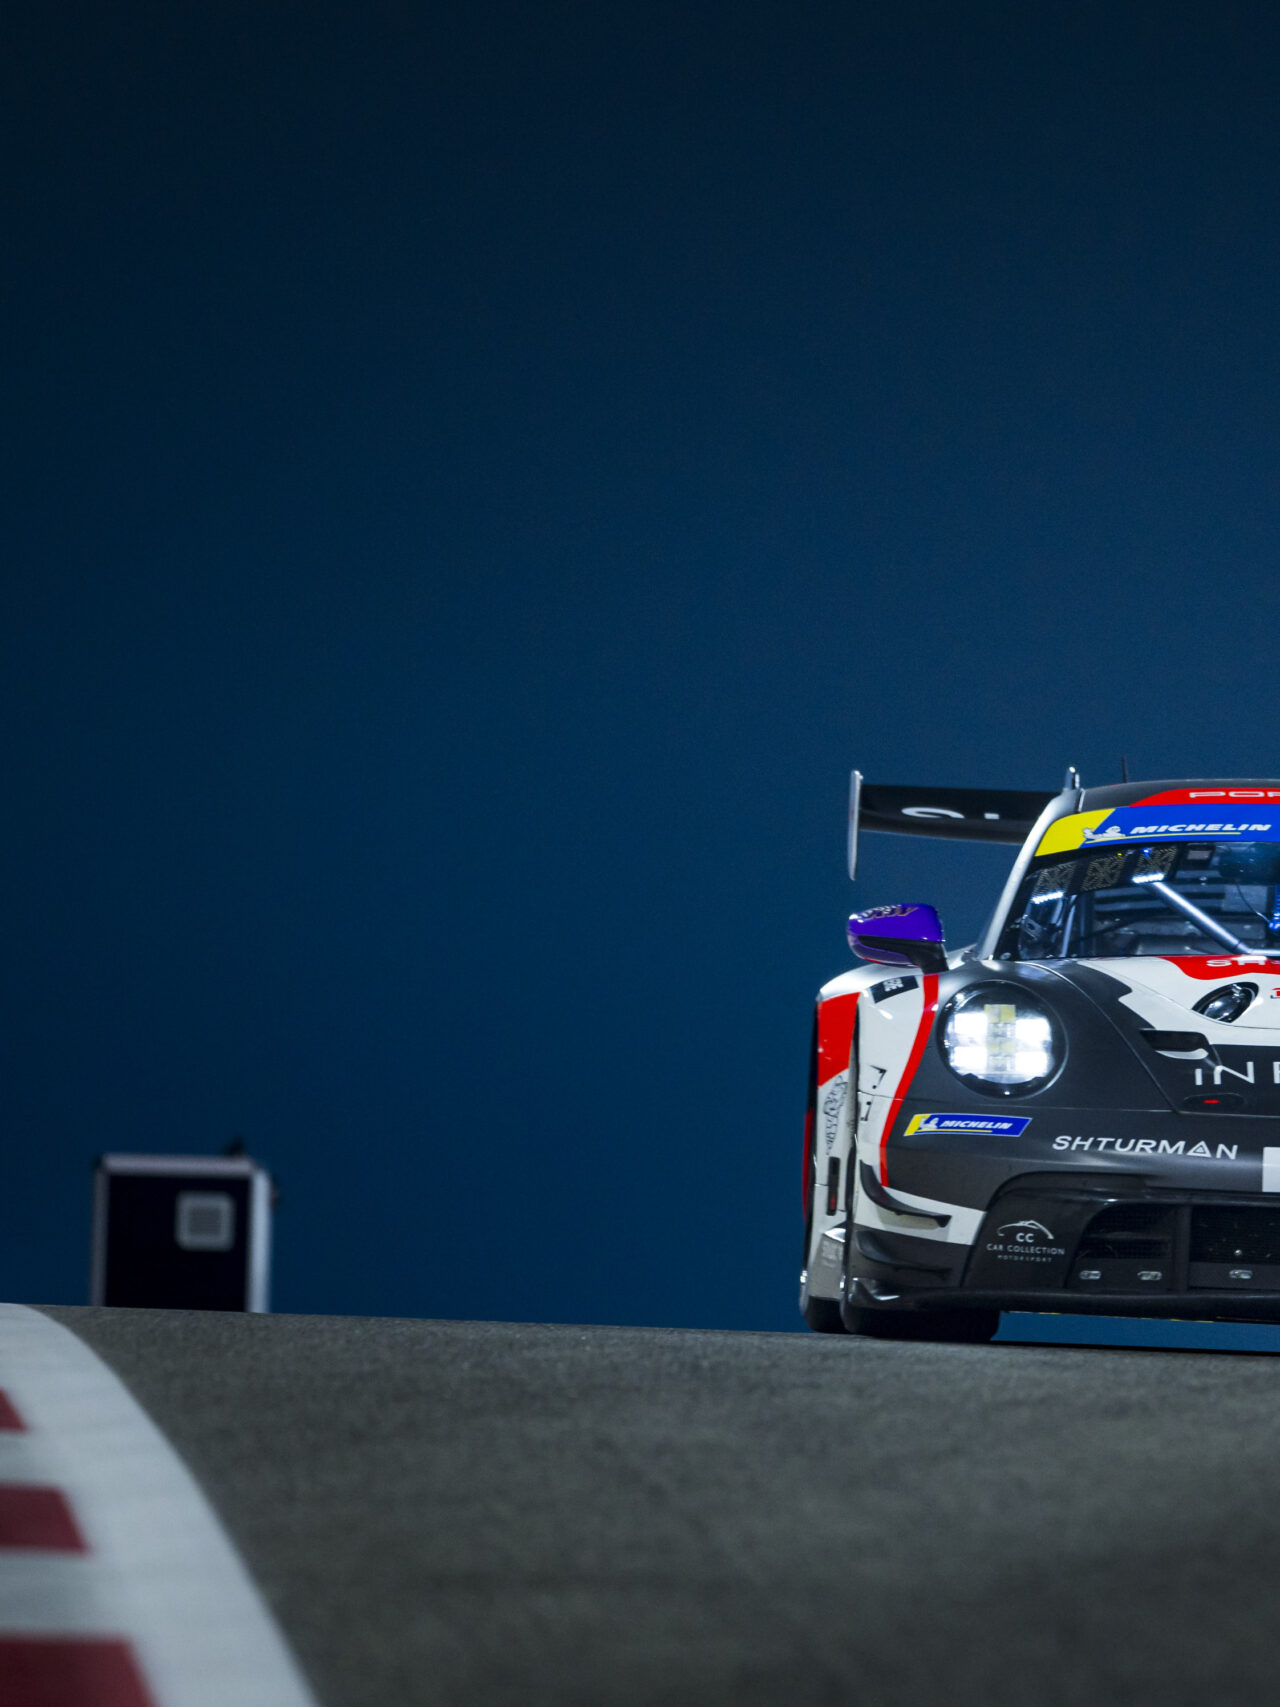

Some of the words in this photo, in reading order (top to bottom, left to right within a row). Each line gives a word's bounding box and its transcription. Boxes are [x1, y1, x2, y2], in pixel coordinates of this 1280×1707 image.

[1129, 823, 1272, 835] MICHELIN
[940, 1119, 1012, 1130] MICHELIN
[1052, 1135, 1238, 1160] SHTURMAN
[986, 1243, 1004, 1251] CAR
[1007, 1244, 1065, 1255] COLLECTION
